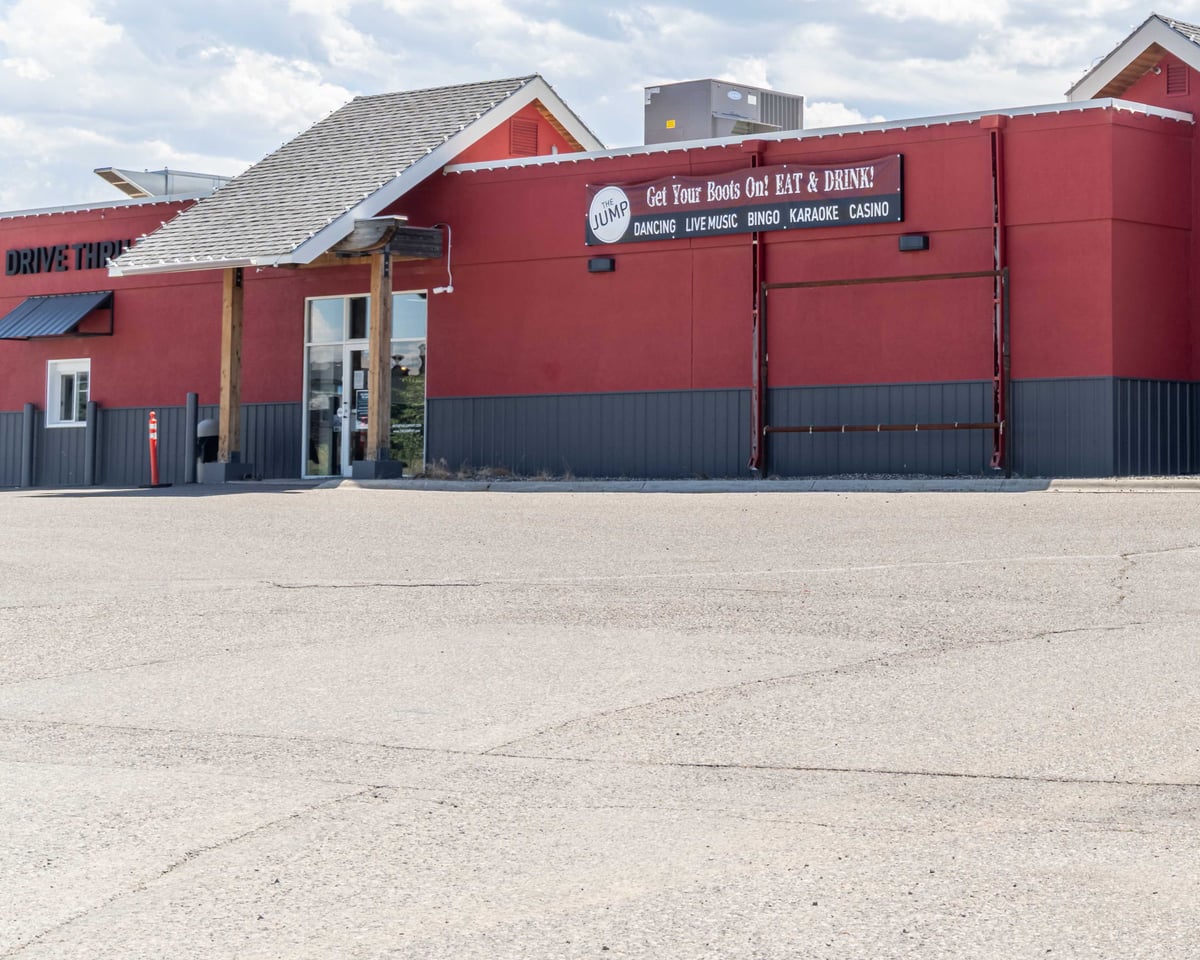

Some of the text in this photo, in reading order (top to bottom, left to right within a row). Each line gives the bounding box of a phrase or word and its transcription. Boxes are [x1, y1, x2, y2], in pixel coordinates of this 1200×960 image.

[646, 166, 875, 208] Get Your Boots On! EAT & DRINK!
[592, 200, 629, 231] JUMP
[601, 198, 614, 209] THE
[633, 201, 889, 237] DANCING LIVE MUSIC BINGO KARAOKE CASINO
[5, 244, 69, 276] DRIVE
